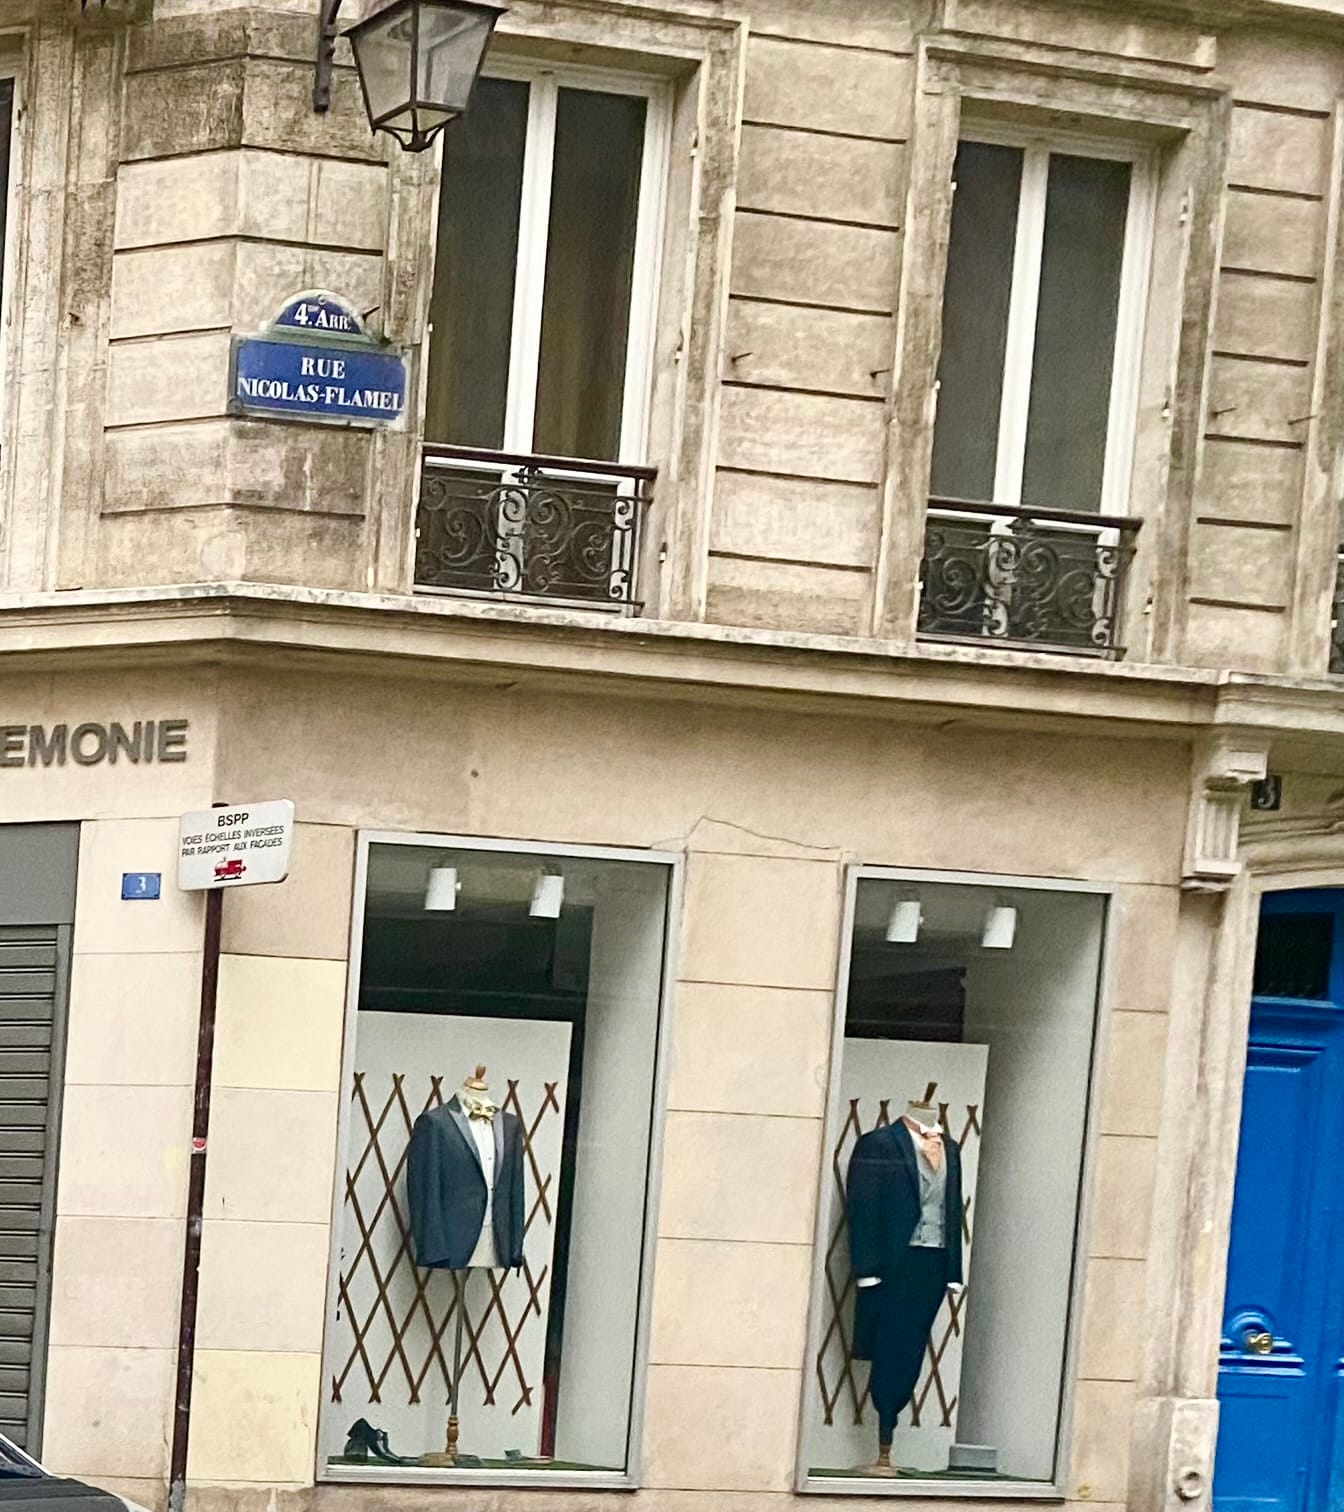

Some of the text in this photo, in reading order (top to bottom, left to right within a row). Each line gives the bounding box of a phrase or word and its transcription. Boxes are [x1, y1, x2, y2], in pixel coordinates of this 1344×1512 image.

[300, 356, 345, 379] RUE
[236, 376, 405, 412] NICOLAS-FLAMEL
[217, 812, 250, 828] BSPP
[182, 834, 203, 846] VOIES
[181, 847, 195, 857] PAR
[197, 843, 231, 855] RAPPORT
[233, 841, 248, 851] AUX
[137, 876, 147, 894] 3
